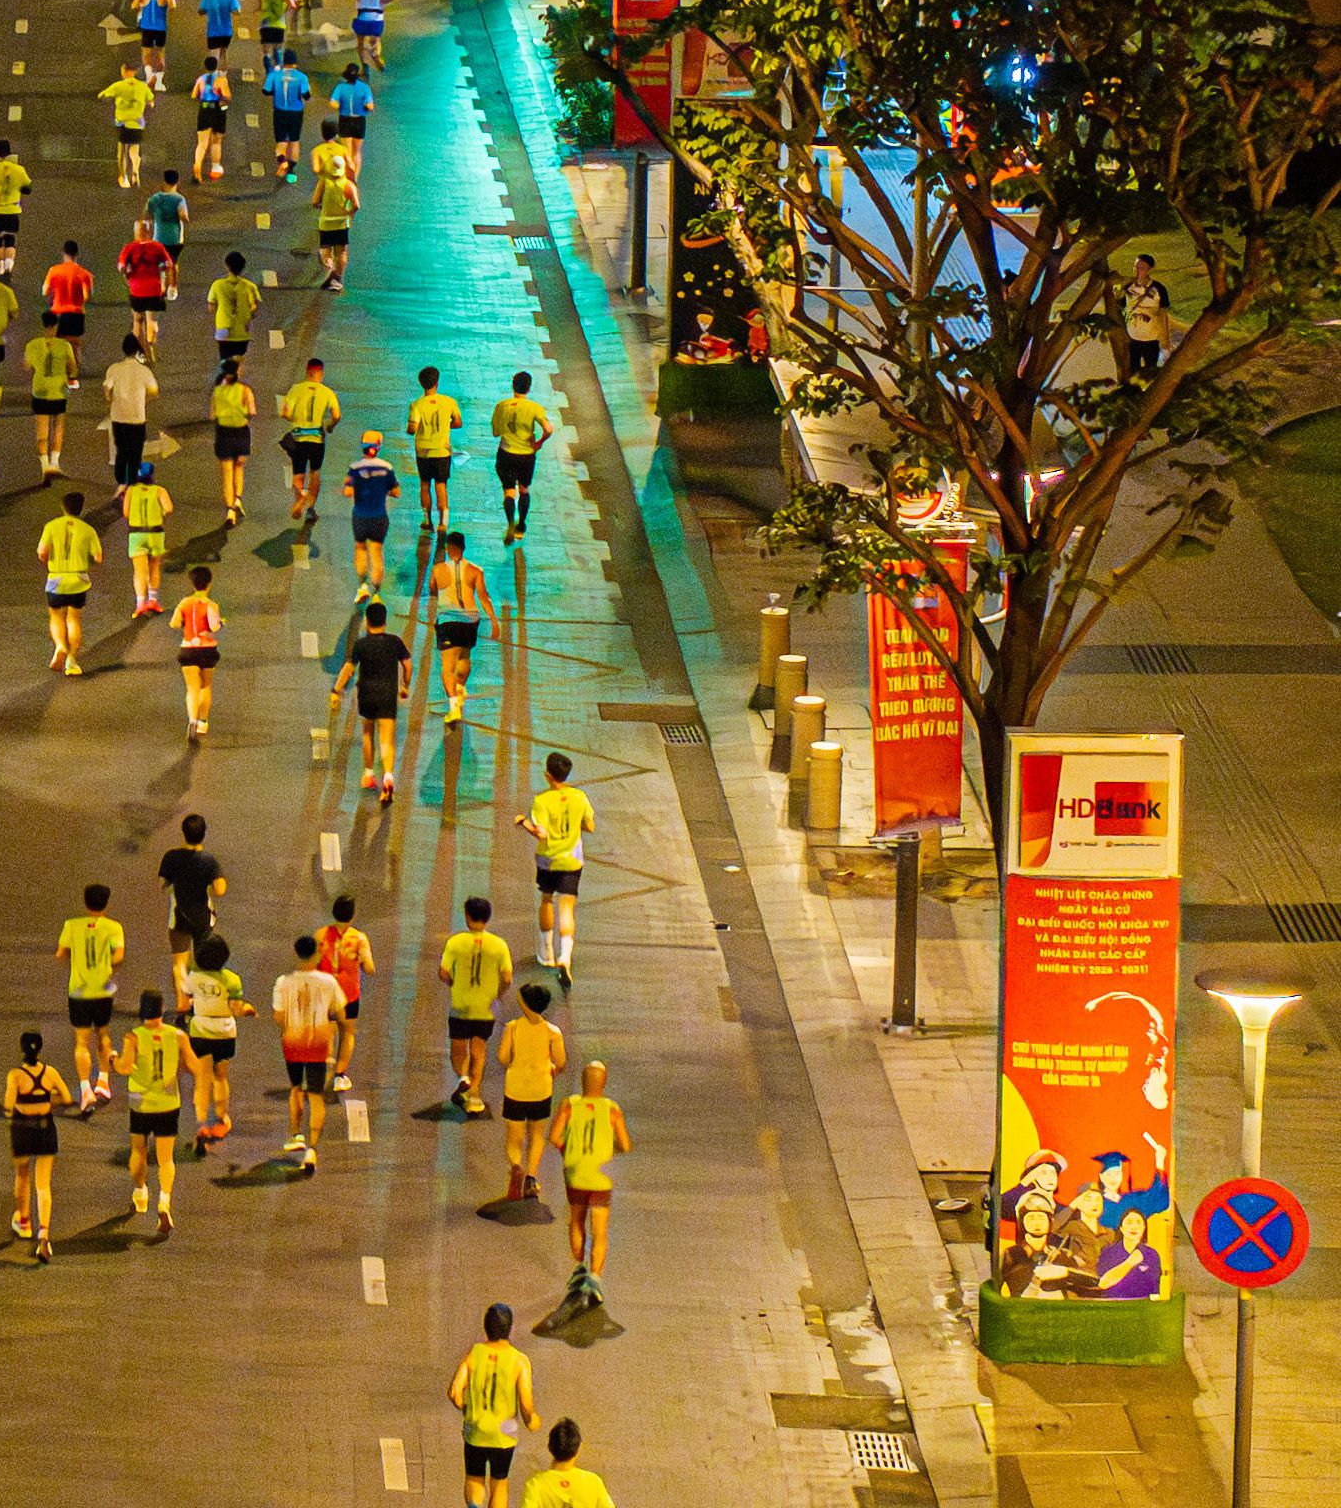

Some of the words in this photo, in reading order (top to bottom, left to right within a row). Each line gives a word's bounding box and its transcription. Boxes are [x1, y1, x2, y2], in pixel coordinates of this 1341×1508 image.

[910, 650, 952, 667] LUY
[879, 699, 909, 718] THEO
[1058, 797, 1162, 820] HDBank
[1035, 888, 1065, 901] NHIỆT
[1067, 889, 1087, 902] LIỆT
[1089, 888, 1120, 901] CHÀO
